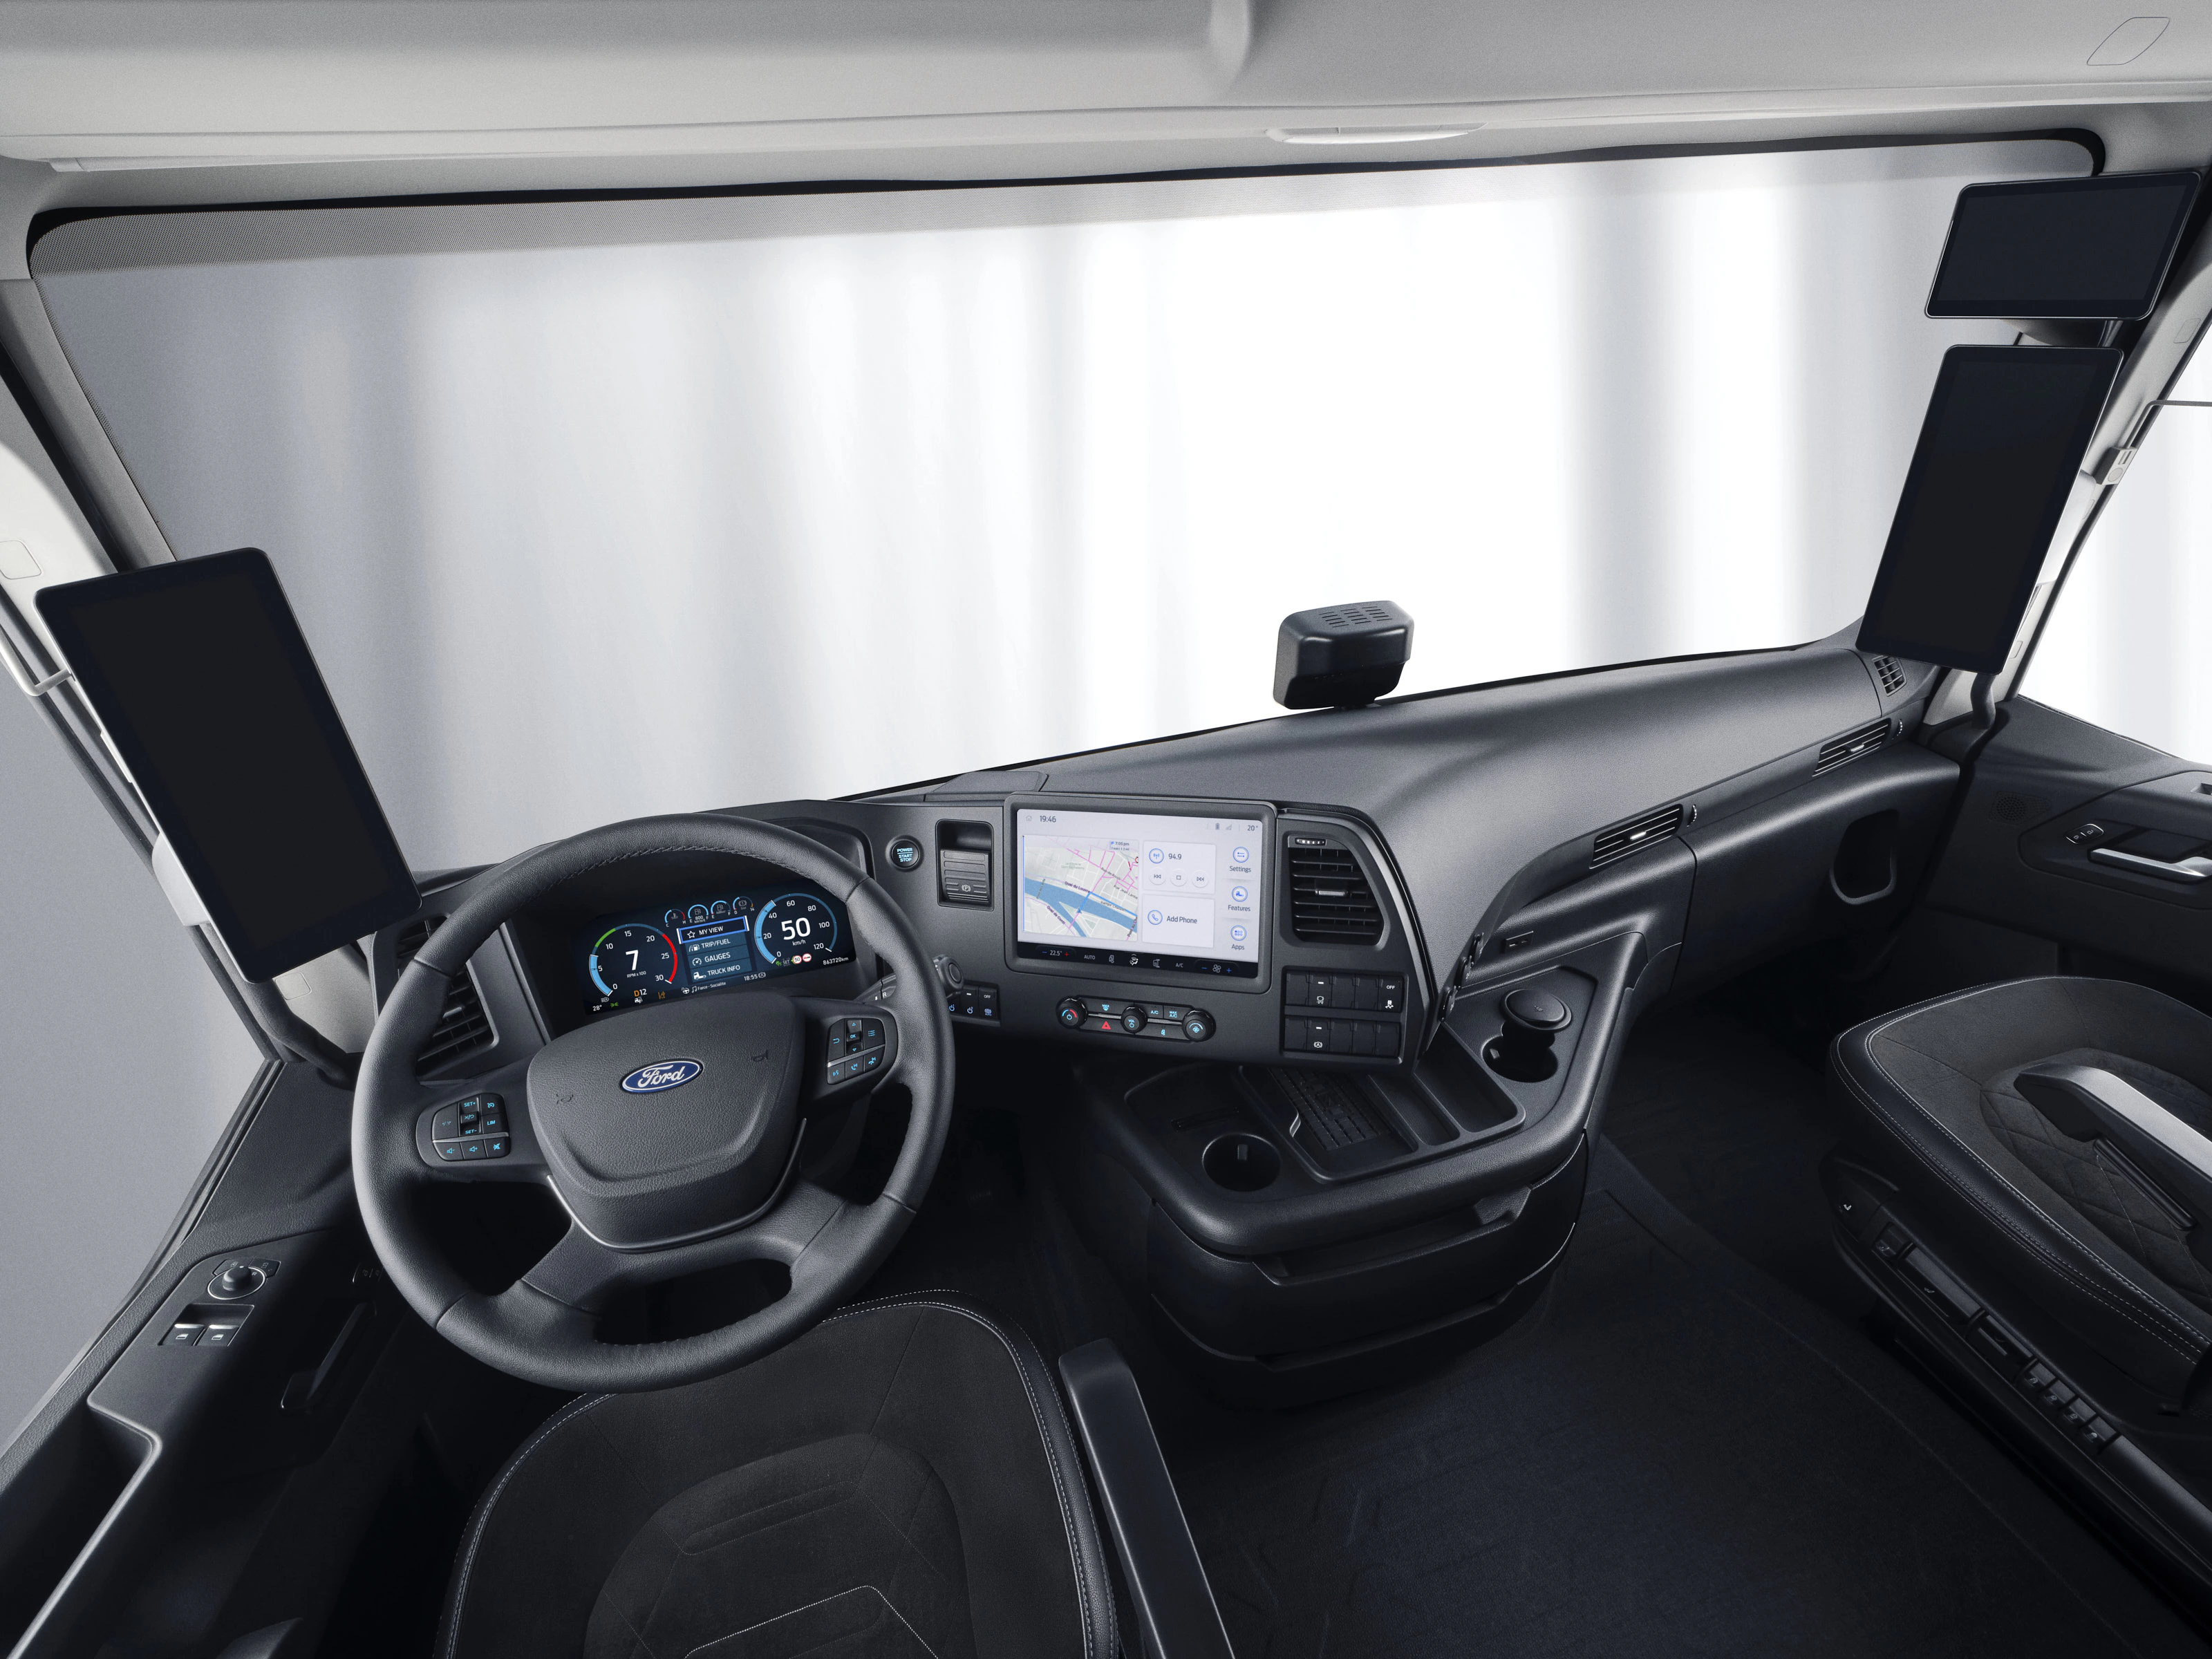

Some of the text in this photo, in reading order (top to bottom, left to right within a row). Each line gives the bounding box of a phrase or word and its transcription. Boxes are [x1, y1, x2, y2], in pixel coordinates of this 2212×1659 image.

[781, 917, 811, 940] 50
[701, 939, 731, 948] TRIP/FUEL
[626, 950, 639, 971] 7
[705, 952, 731, 962] GAUGES
[707, 968, 726, 976] TRUCK
[637, 1065, 685, 1087] Ford
